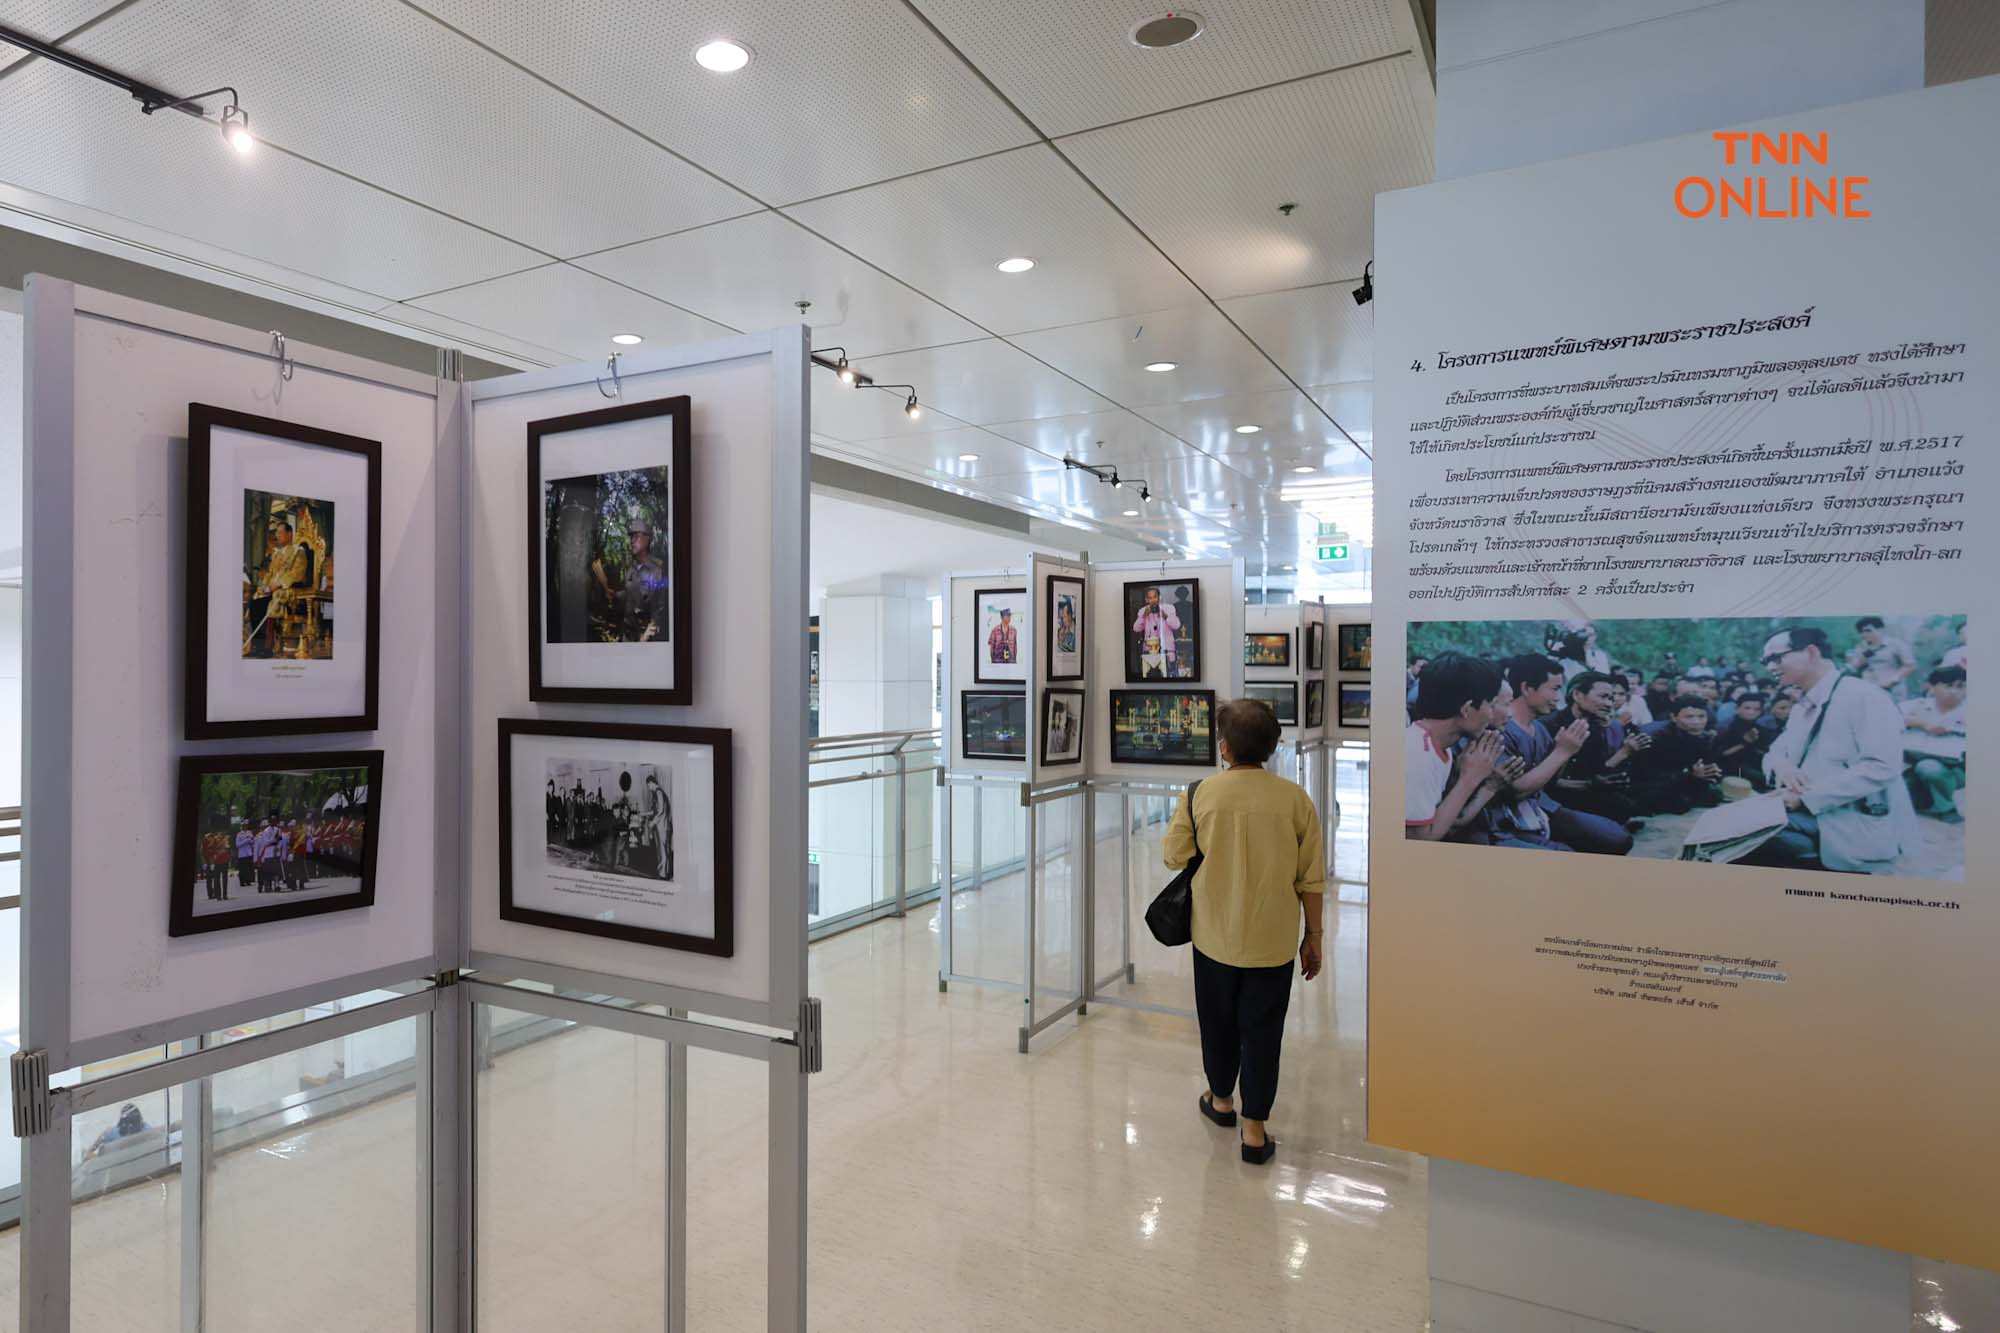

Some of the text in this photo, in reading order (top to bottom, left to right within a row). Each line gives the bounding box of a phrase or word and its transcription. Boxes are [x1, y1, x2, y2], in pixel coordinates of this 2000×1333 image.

[1410, 306, 1815, 374] 4. โครงการแพทย์พิเศษตามพระราชประสงค์
[1446, 342, 1967, 405] เป็นโครงการที่พระบาทสมเด็จพระปรมินทรมหาภูมิพลอดุลยเดช ทรงได้ศึกษา
[1788, 370, 1965, 398] จนได้ผลดีแล้วจึงนำมา
[1410, 429, 1596, 455] ใช้ให้เกิดประโยชน์แก่ประชาชน
[1445, 434, 1965, 482] โดยโครงการแพทย์พิเศษตามพระราชประสงค์เกิดขึ้นครั้งแรกเมื่อปี พ.ศ.2517
[1409, 460, 1965, 508] เพื่อบรรเทาความเจ็บปวดของราษฎรที่นิคมสร้างตนเองพัฒนาภาคใต้ อำเภอแว้ง
[1409, 492, 1965, 531] จังหวัดนราธิวาส ซึ่งในขณะนั้นมีสถานีอนามัยเพียงแห่งเดียว จึงทรงพระกรุณา
[1409, 517, 1964, 554] โปรดเกล้าฯ ให้กระทรวงสาธารณสุขจัดแพทย์หมุนเวียนเข้าไปบริการตรวจรักษา
[1409, 545, 1962, 577] พร้อมด้วยแพทย์และเจ้าหน้าที่จากโรงพยาบาลนราธิวาส และโรงพยาบาลสุไหงโก-ลก
[1409, 578, 1694, 602] ออกไปปฏิบัติการสัปดาห์ละ 2 ครั้งเป็นประจำ
[1830, 891, 1960, 909] kanchanapisek.or.th
